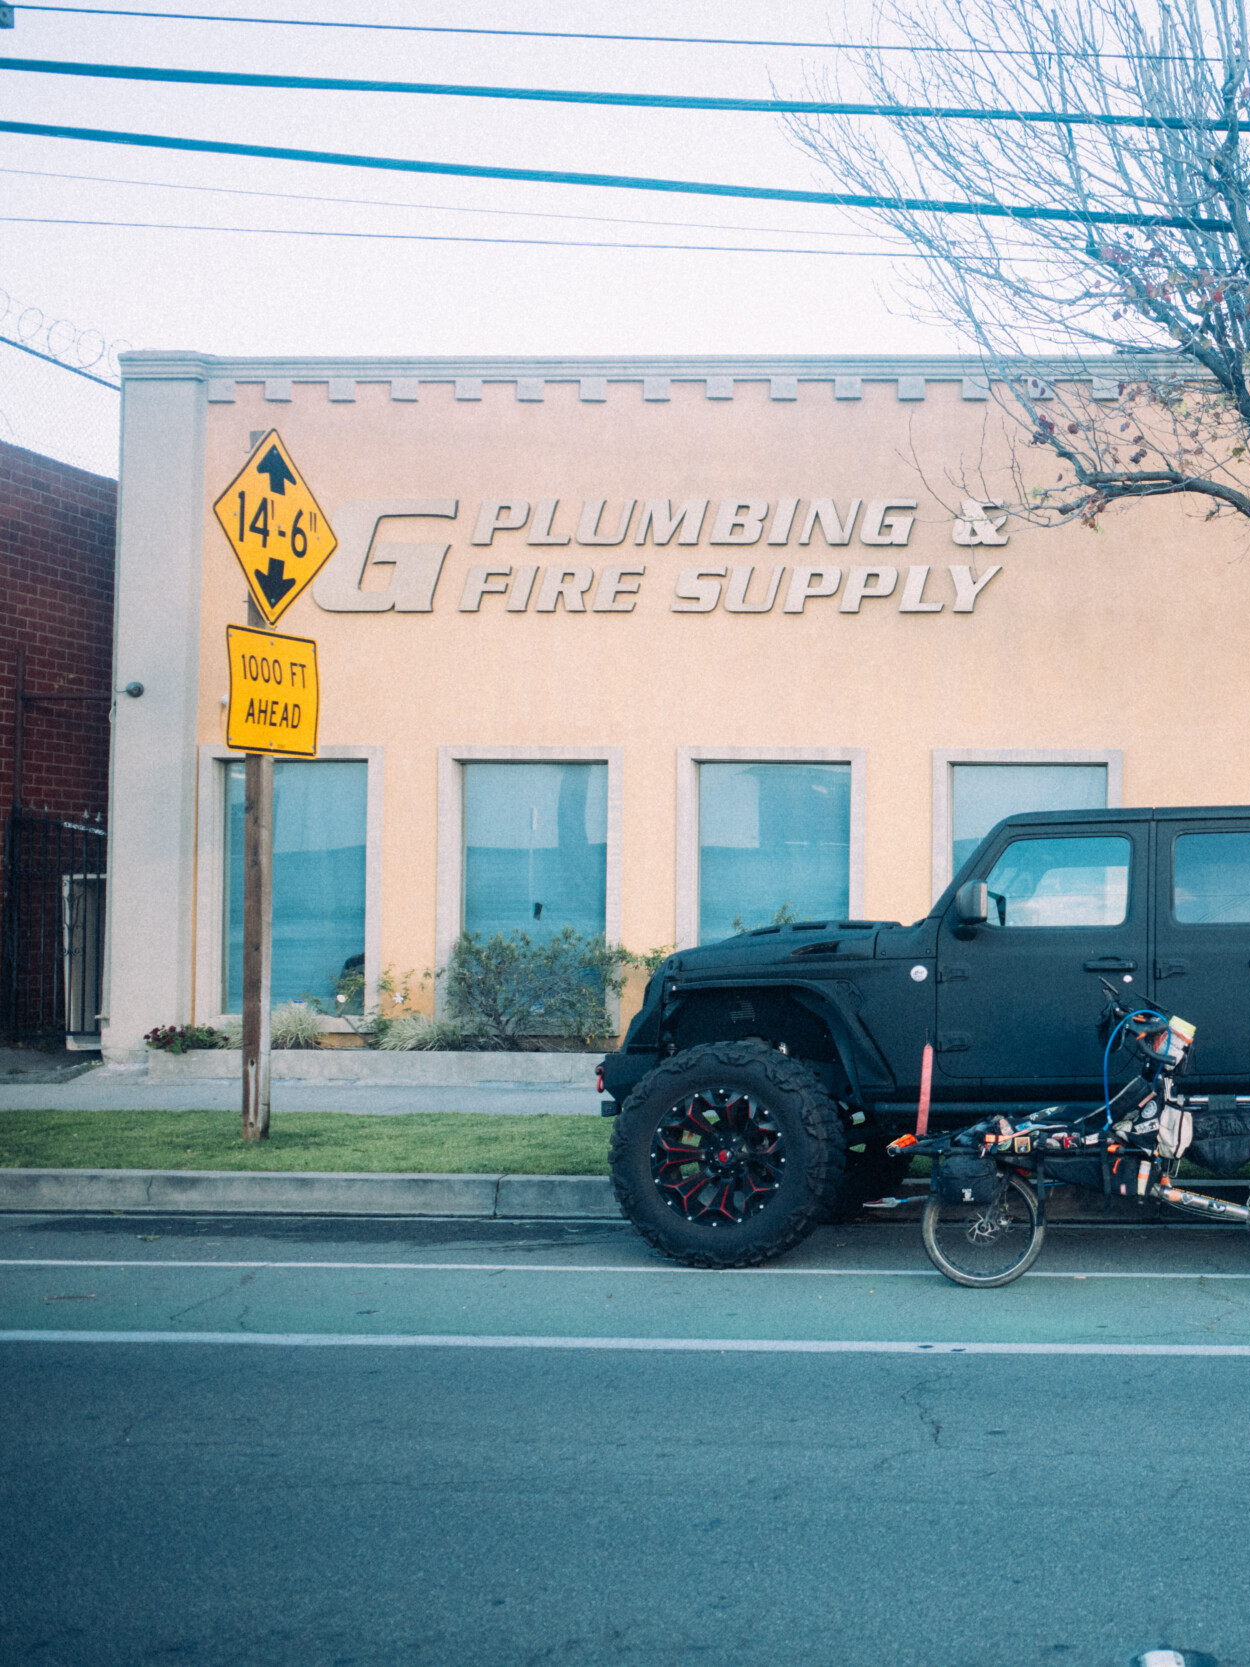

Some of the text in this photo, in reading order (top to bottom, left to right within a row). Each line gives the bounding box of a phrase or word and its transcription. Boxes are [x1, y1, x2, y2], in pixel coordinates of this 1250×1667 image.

[471, 498, 1011, 546] PLUMBING &
[312, 498, 459, 613] G
[458, 564, 1003, 614] FIRE SUPPLY
[241, 653, 307, 689] 1000 FT
[245, 697, 302, 730] AHEAD
